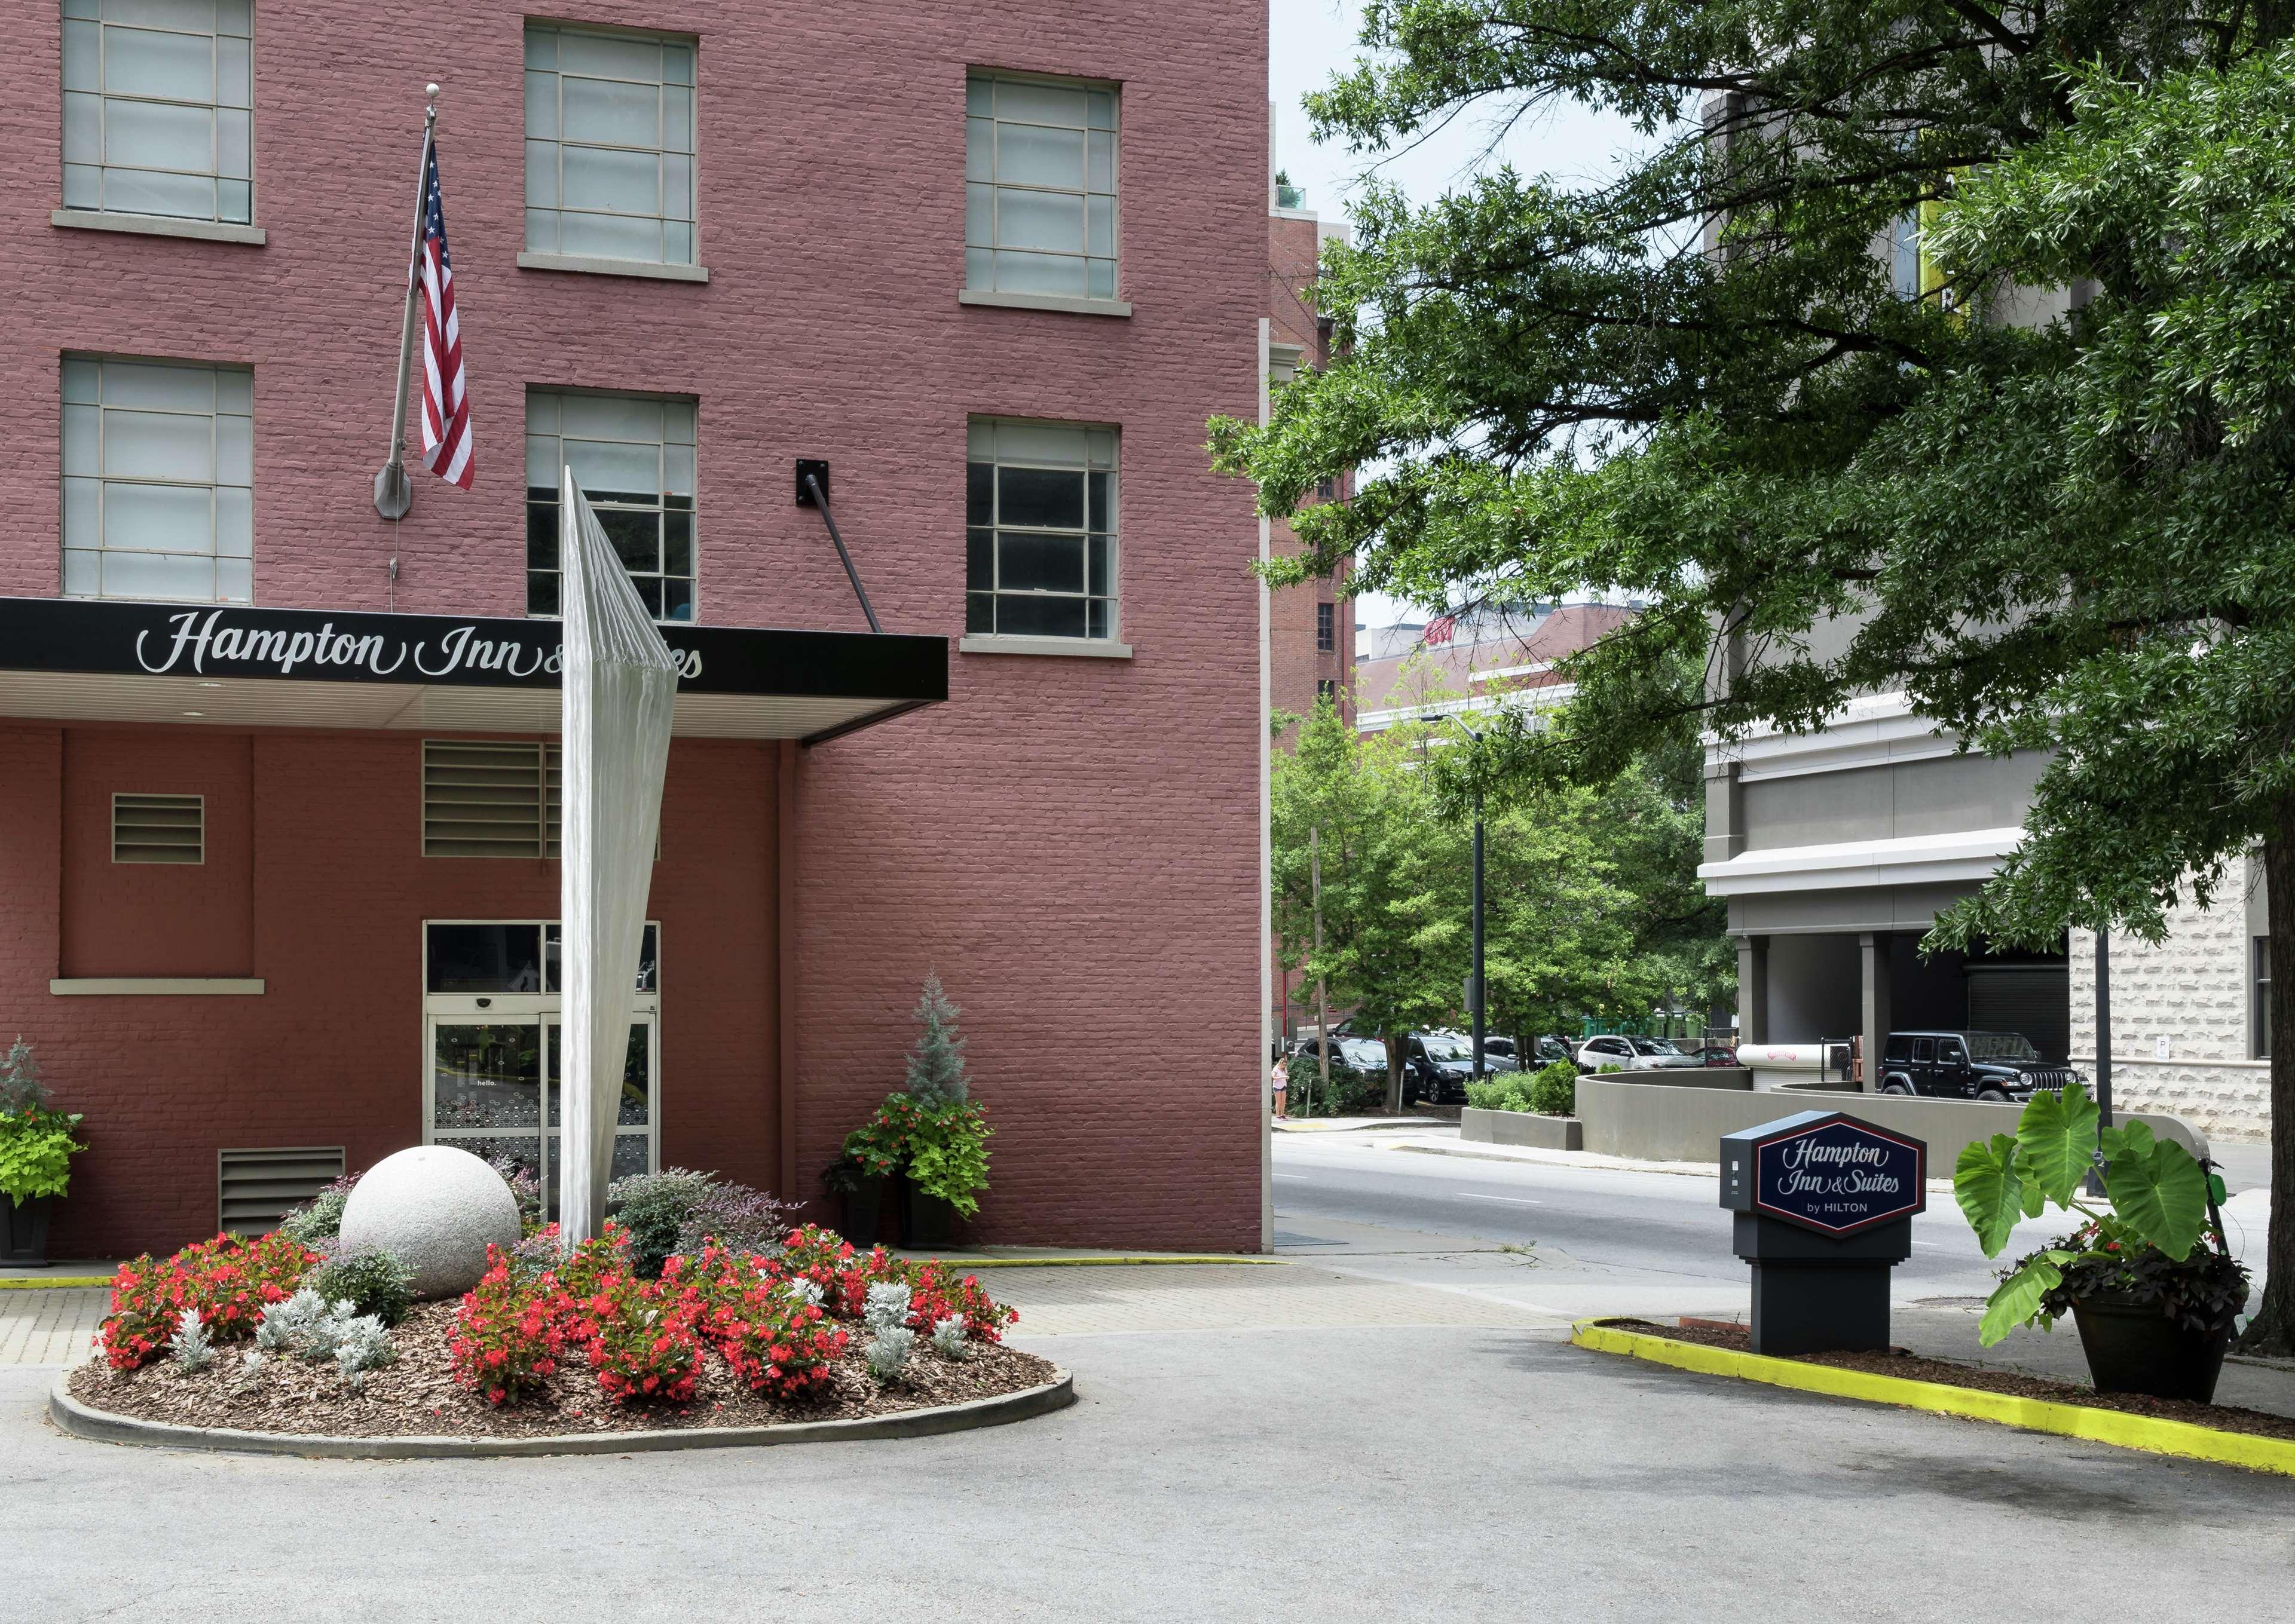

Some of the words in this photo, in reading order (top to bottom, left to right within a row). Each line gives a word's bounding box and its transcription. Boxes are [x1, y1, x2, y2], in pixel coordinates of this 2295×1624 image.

[137, 610, 406, 675] Hampton
[415, 626, 543, 676] Inn
[1782, 1138, 1889, 1170] Hampton
[1777, 1169, 1831, 1195] Inn
[1832, 1176, 1845, 1195] &
[1843, 1169, 1899, 1194] Suites
[1807, 1203, 1820, 1214] by
[1825, 1203, 1868, 1213] HILTON
